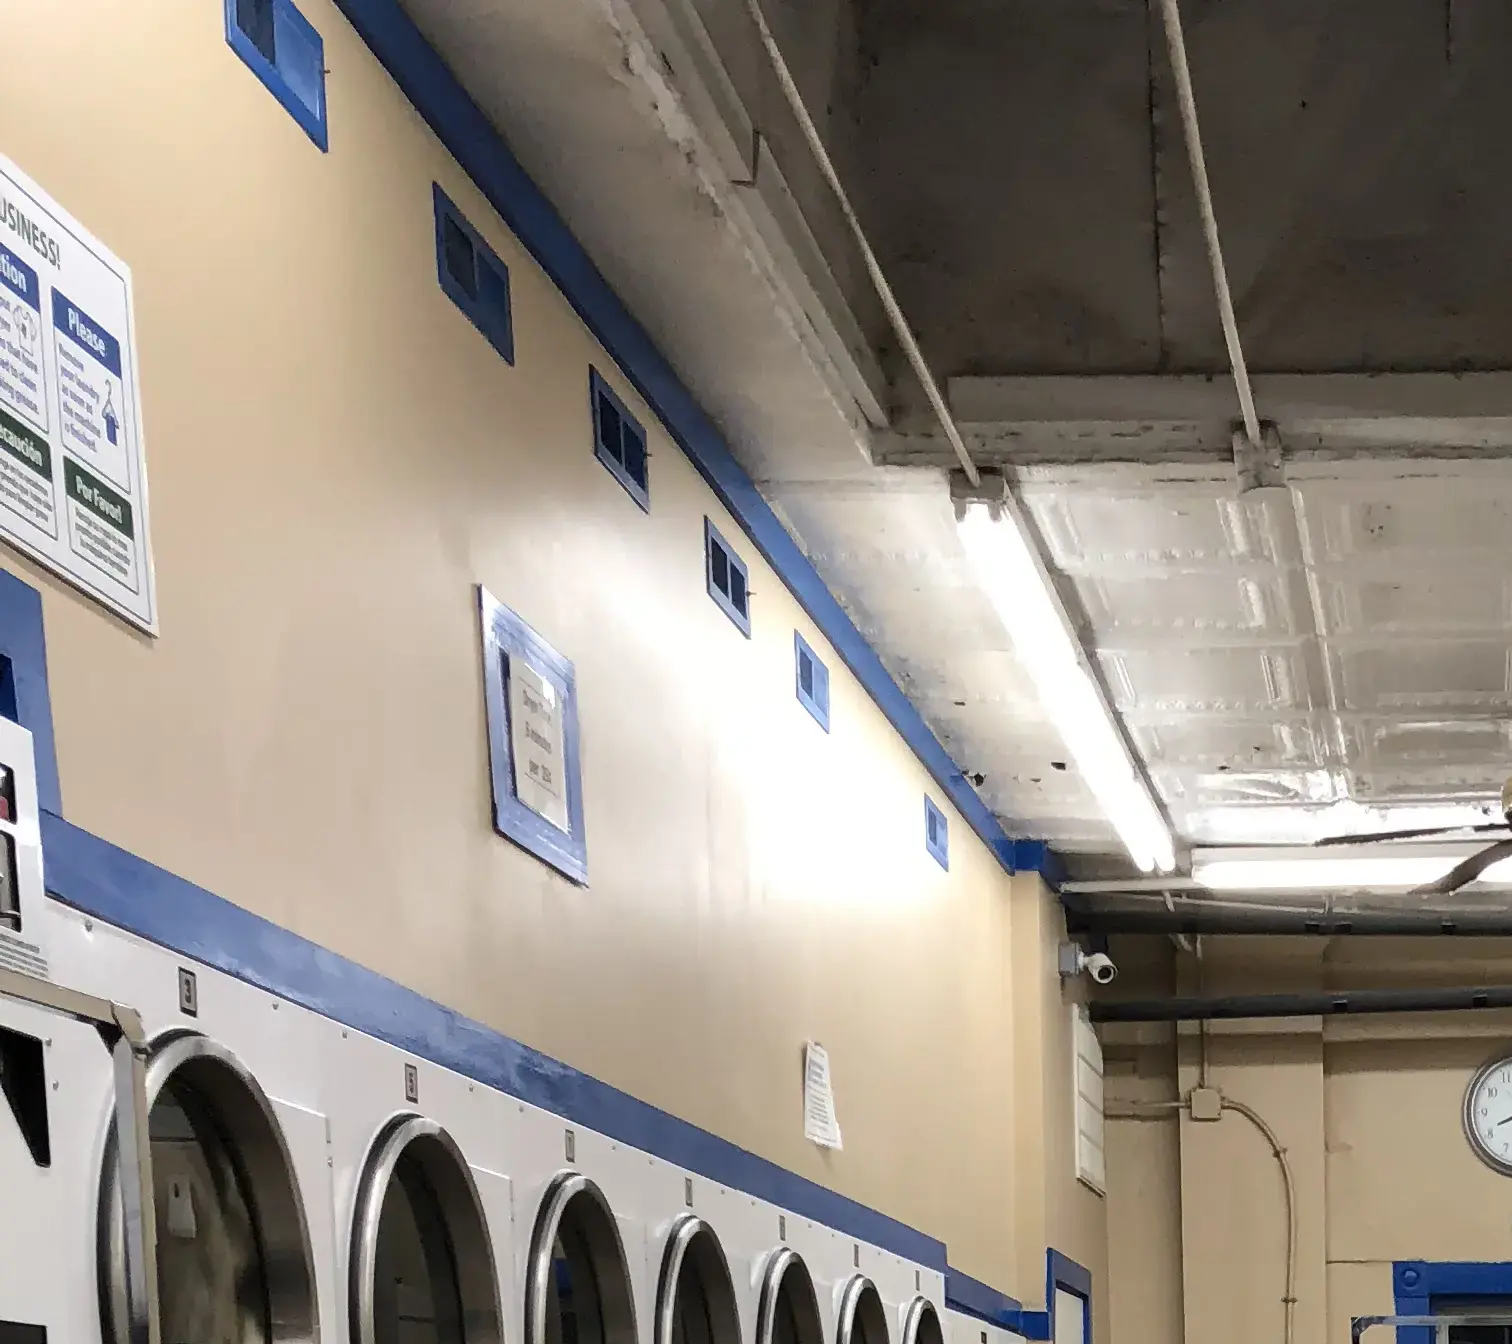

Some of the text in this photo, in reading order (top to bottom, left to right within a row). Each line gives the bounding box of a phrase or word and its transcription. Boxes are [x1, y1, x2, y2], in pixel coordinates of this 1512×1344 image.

[68, 308, 106, 358] Please
[1502, 1072, 1511, 1083] 11
[1488, 1087, 1498, 1098] 10
[1481, 1108, 1488, 1118] 9
[1487, 1128, 1493, 1139] 8
[1503, 1142, 1509, 1153] 7
